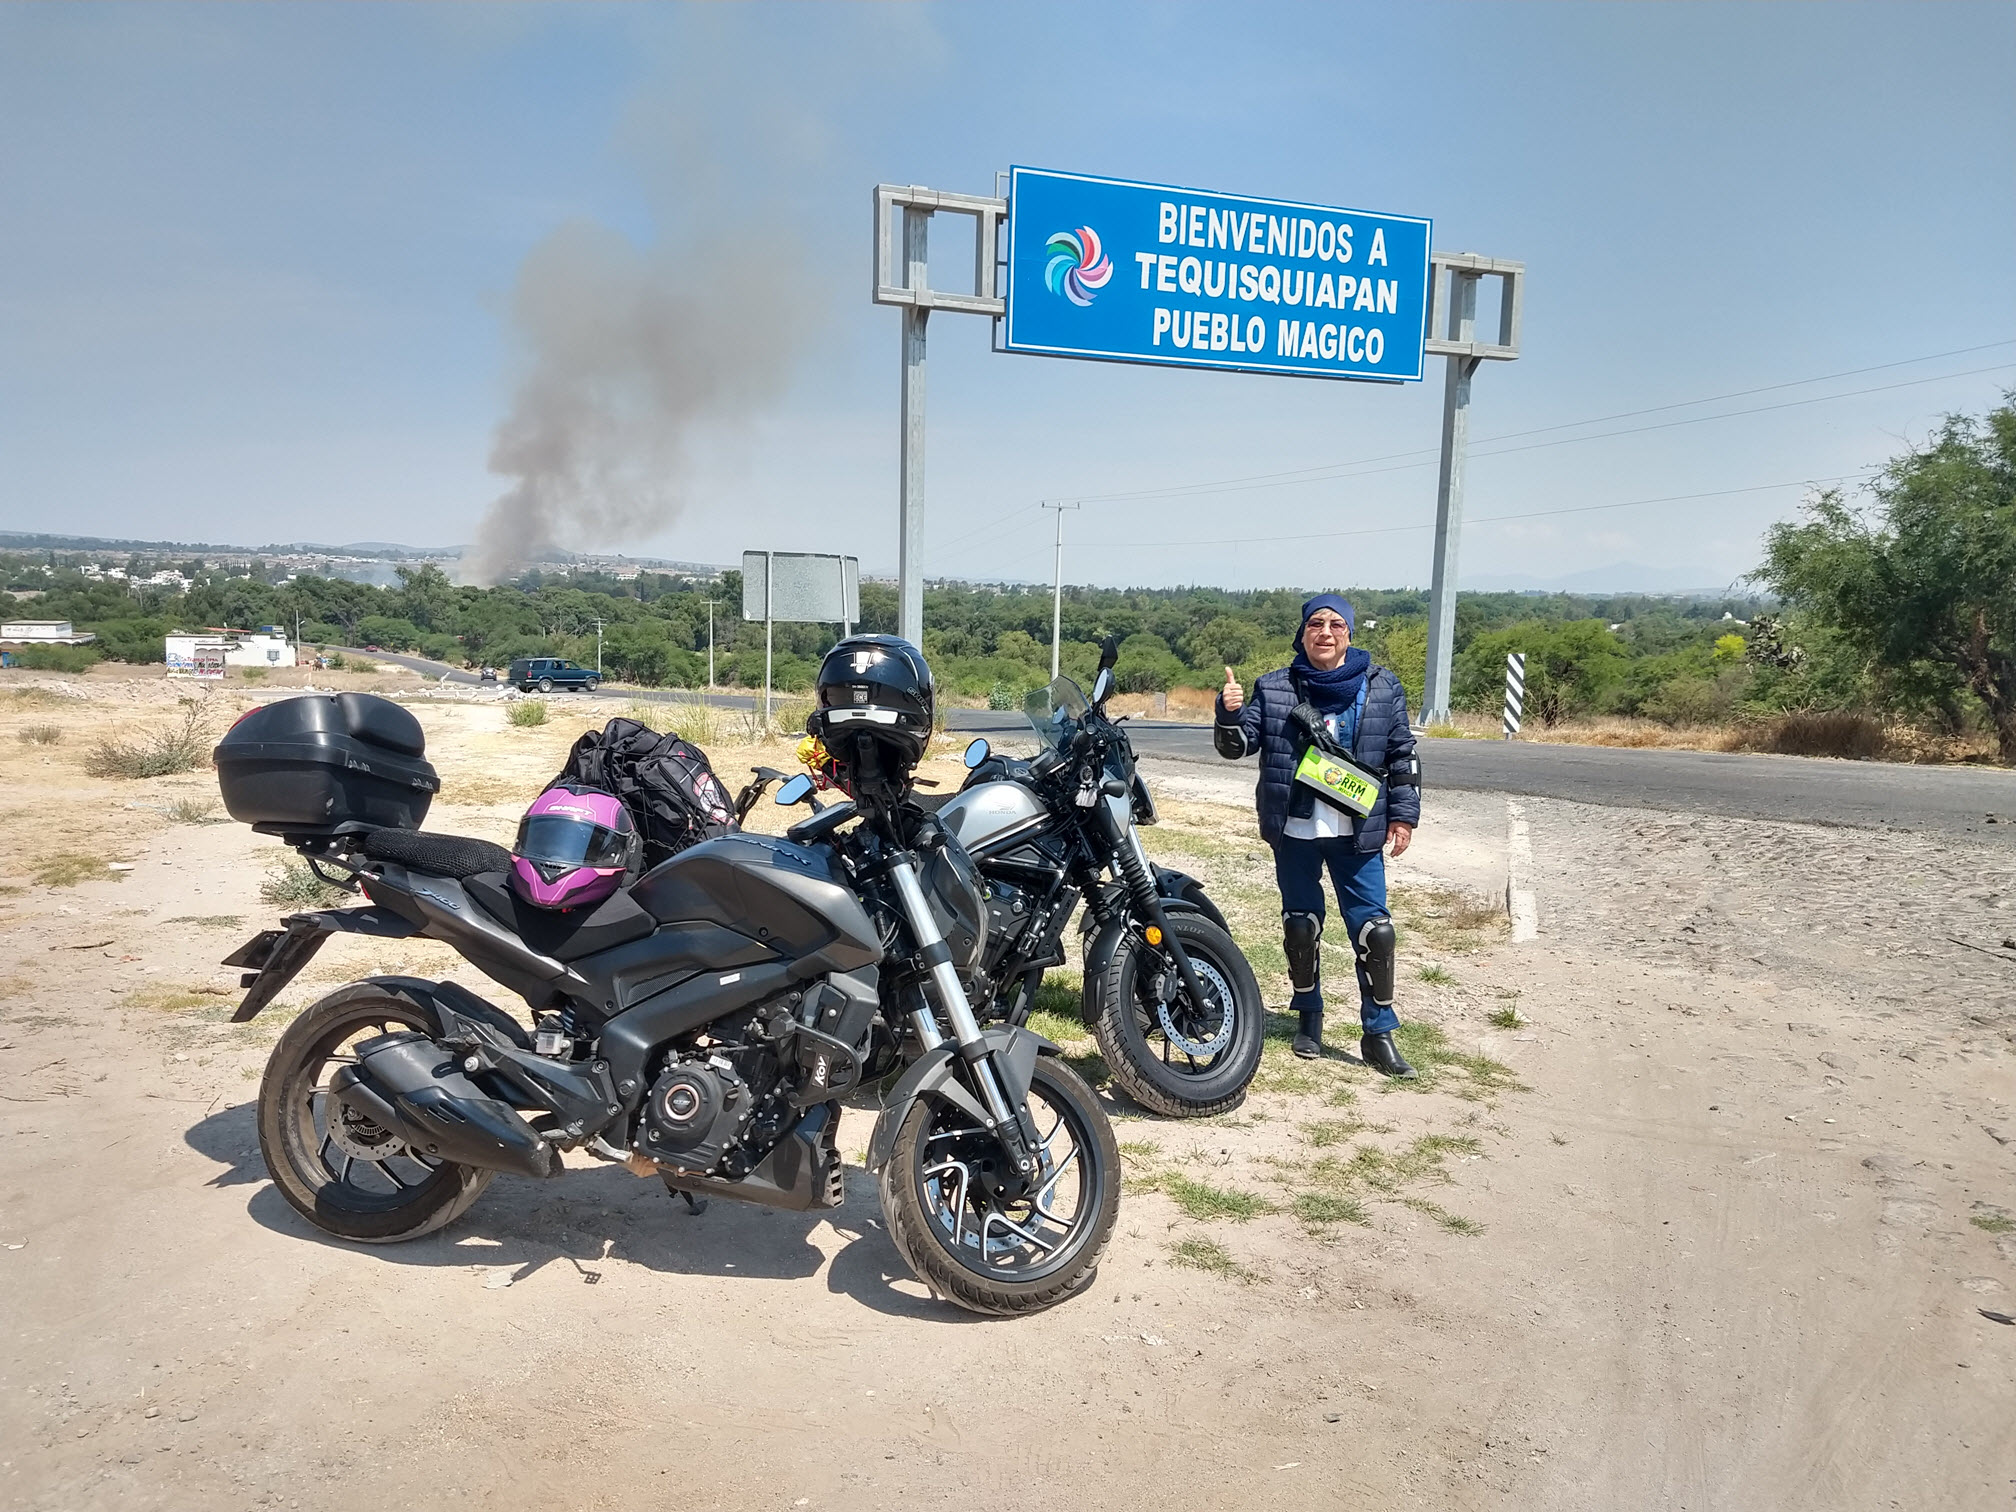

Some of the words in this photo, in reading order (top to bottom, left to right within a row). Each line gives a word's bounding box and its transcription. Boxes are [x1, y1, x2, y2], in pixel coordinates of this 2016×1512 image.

[1158, 202, 1353, 264] BIENVENIDOS
[1368, 228, 1388, 267] A
[1135, 252, 1398, 314] TEQUISQUIAPAN
[1153, 307, 1266, 353] PUEBLO
[1277, 319, 1384, 364] MAGICO
[1340, 777, 1366, 796] RRM
[814, 1055, 827, 1086] KOV
